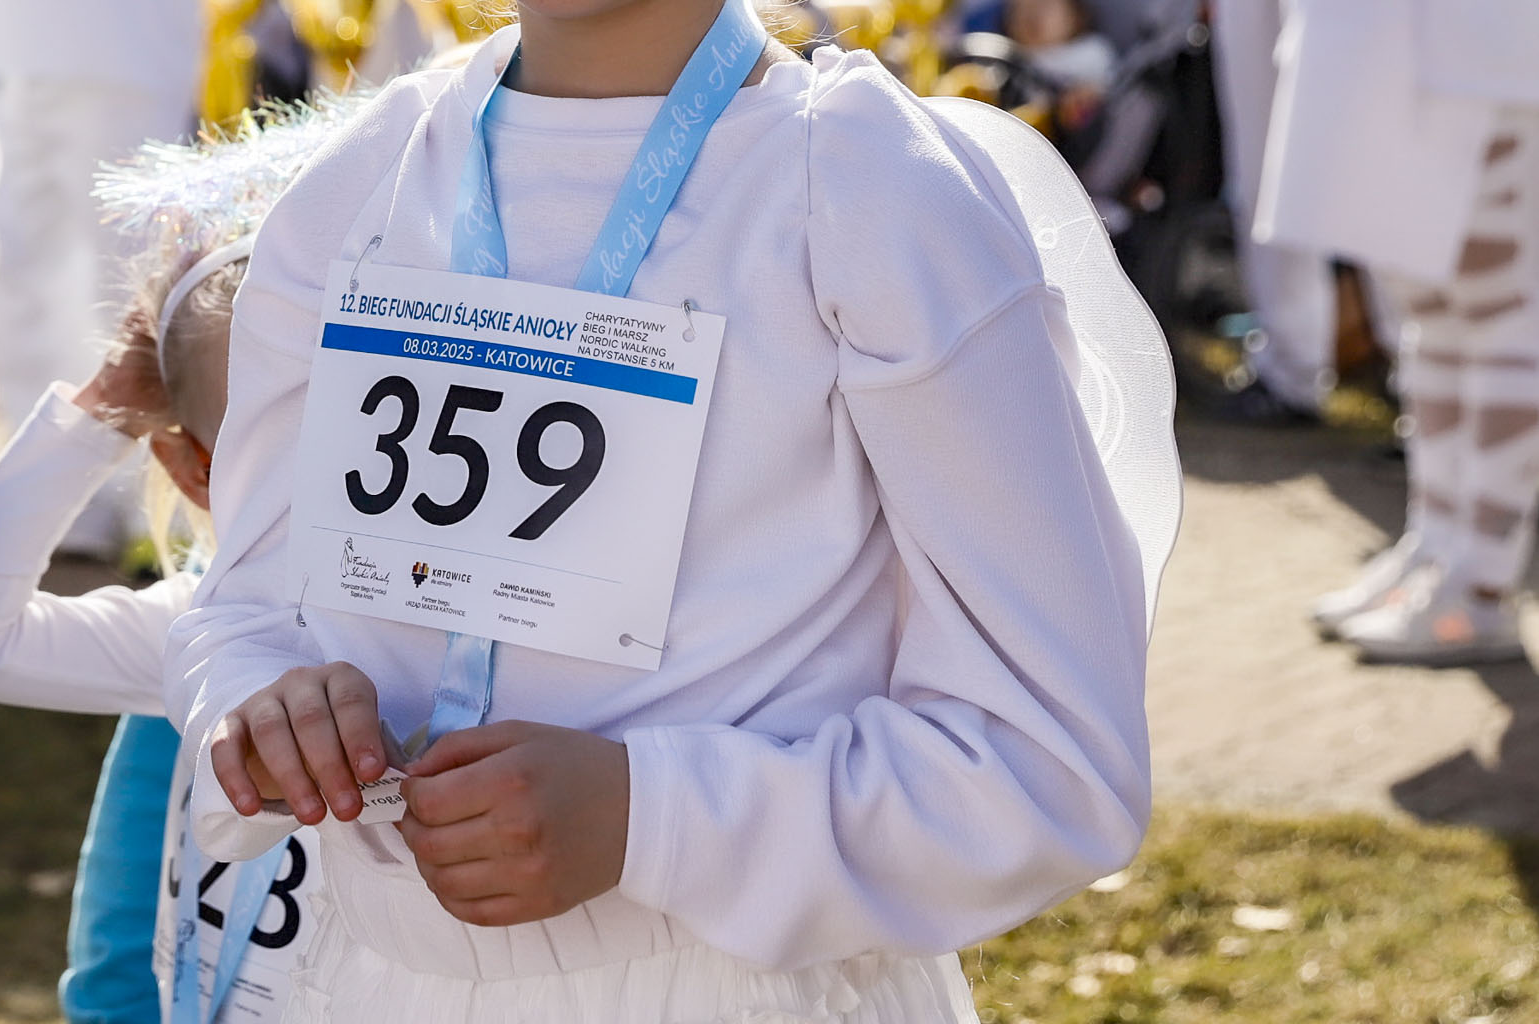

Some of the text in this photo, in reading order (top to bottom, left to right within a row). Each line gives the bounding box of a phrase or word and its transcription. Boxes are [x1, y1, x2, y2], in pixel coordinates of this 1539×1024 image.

[596, 209, 648, 296] dacji
[636, 91, 709, 205] Śląskie
[339, 294, 578, 342] 12. BIEG FUNDACJI ŚLĄSKIE ANIOŁY
[585, 311, 667, 333] CHARYTATYWNY
[582, 322, 607, 337] BIEG
[613, 328, 649, 343] MARSZ
[402, 337, 474, 361] 08.03.2025
[484, 349, 576, 377] KATOWICE
[580, 334, 667, 358] NORDIC WALKING
[577, 345, 675, 371] NA DYSTANSIE 5 KM
[345, 375, 606, 541] 359
[431, 568, 472, 584] KATOWICE
[499, 582, 520, 592] DAWID
[421, 602, 439, 612] MIASTA
[439, 605, 466, 617] KATOWICE
[498, 613, 520, 624] Partner
[371, 791, 403, 806] roga
